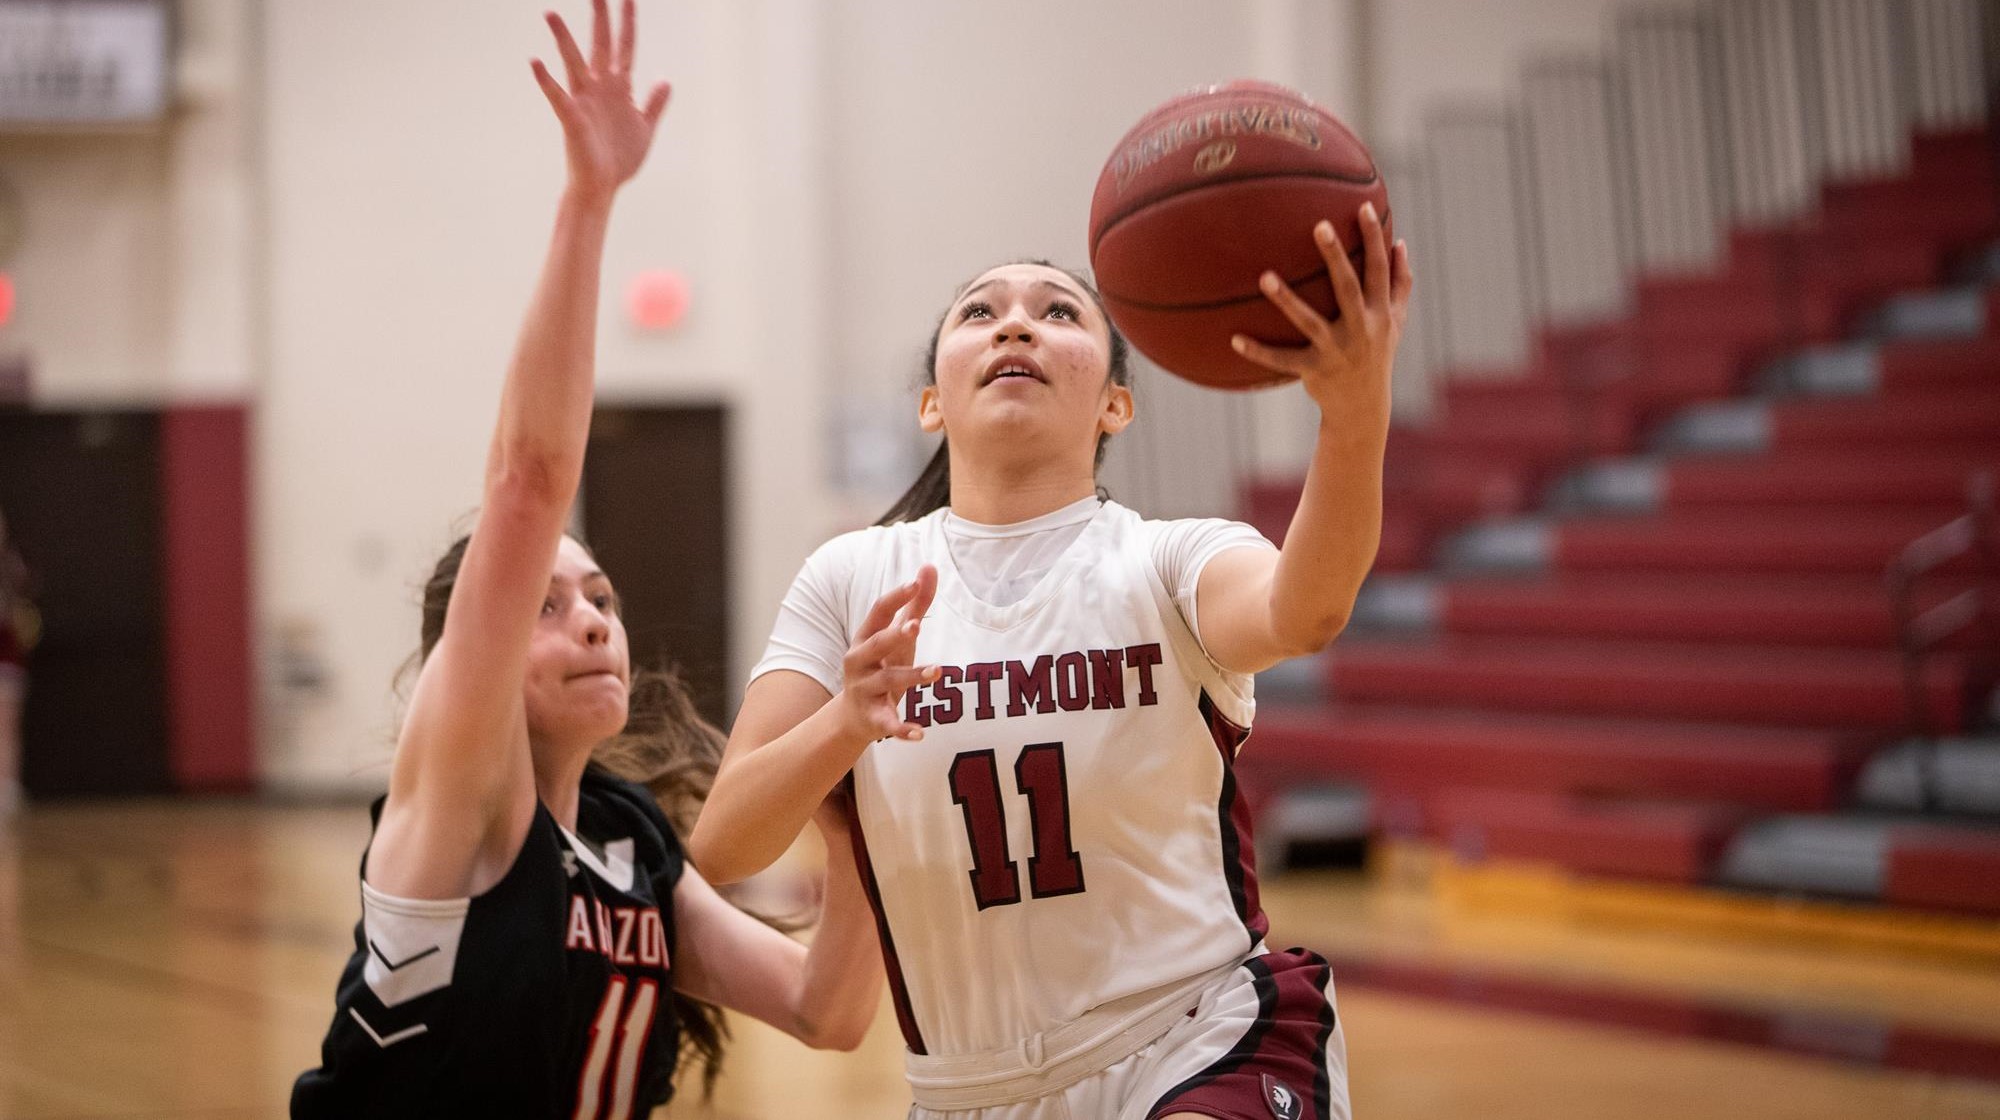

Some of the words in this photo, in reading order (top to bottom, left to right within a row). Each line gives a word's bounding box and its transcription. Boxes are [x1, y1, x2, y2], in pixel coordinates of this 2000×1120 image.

[877, 643, 1163, 743] ESTMONT
[948, 741, 1086, 912] 11
[572, 974, 659, 1120] 11
